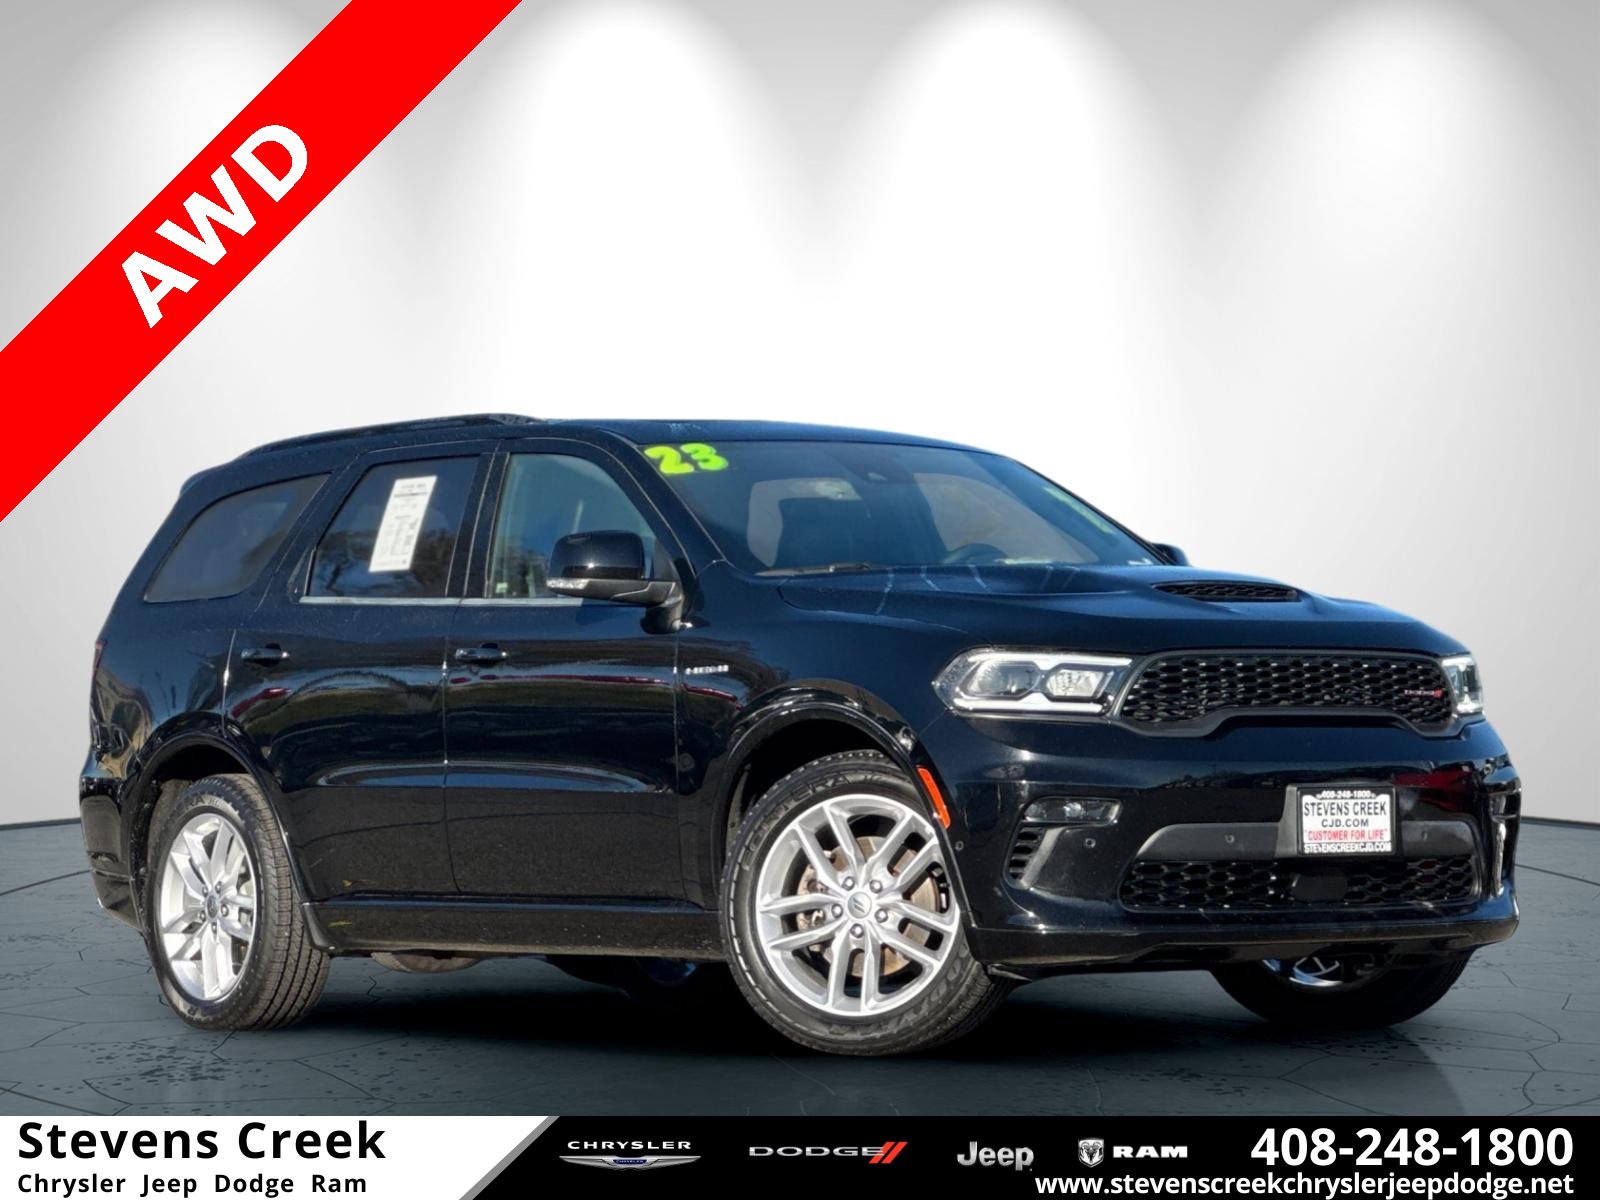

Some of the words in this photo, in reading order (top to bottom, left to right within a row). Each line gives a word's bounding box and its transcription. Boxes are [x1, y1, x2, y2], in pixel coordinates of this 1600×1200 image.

[644, 442, 729, 474] 23
[1320, 789, 1372, 800] 408-248-1800
[1304, 802, 1350, 816] STEVENS
[1353, 801, 1387, 816] CREEK
[1321, 819, 1369, 828] CJD.COM
[1350, 830, 1366, 840] FOR
